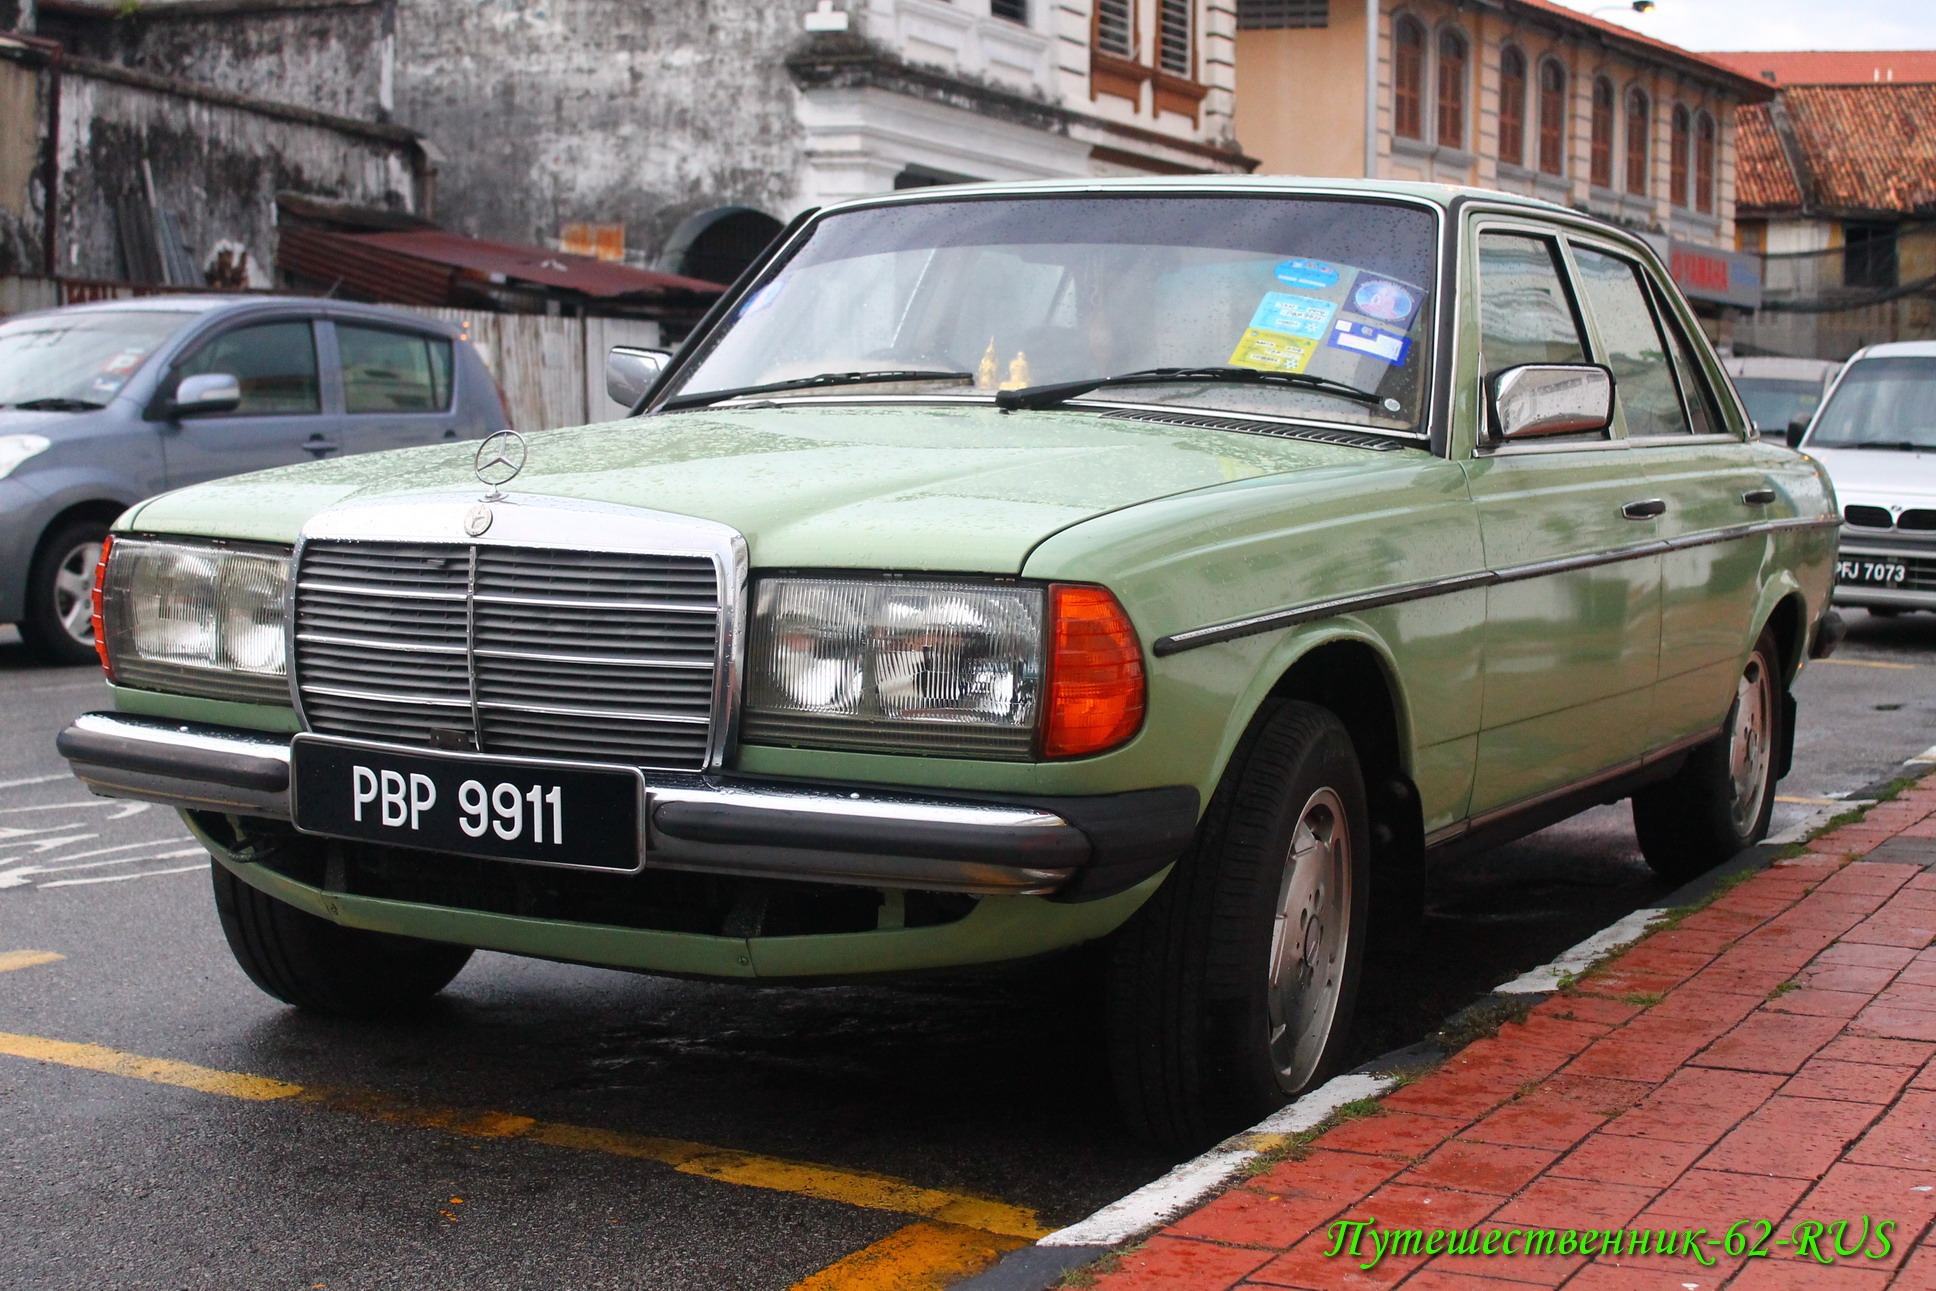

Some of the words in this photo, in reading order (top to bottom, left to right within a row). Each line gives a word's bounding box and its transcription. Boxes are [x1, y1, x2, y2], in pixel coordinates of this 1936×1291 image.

[1863, 562, 1906, 582] 7073
[352, 765, 437, 830] PBP
[458, 779, 563, 845] 9911
